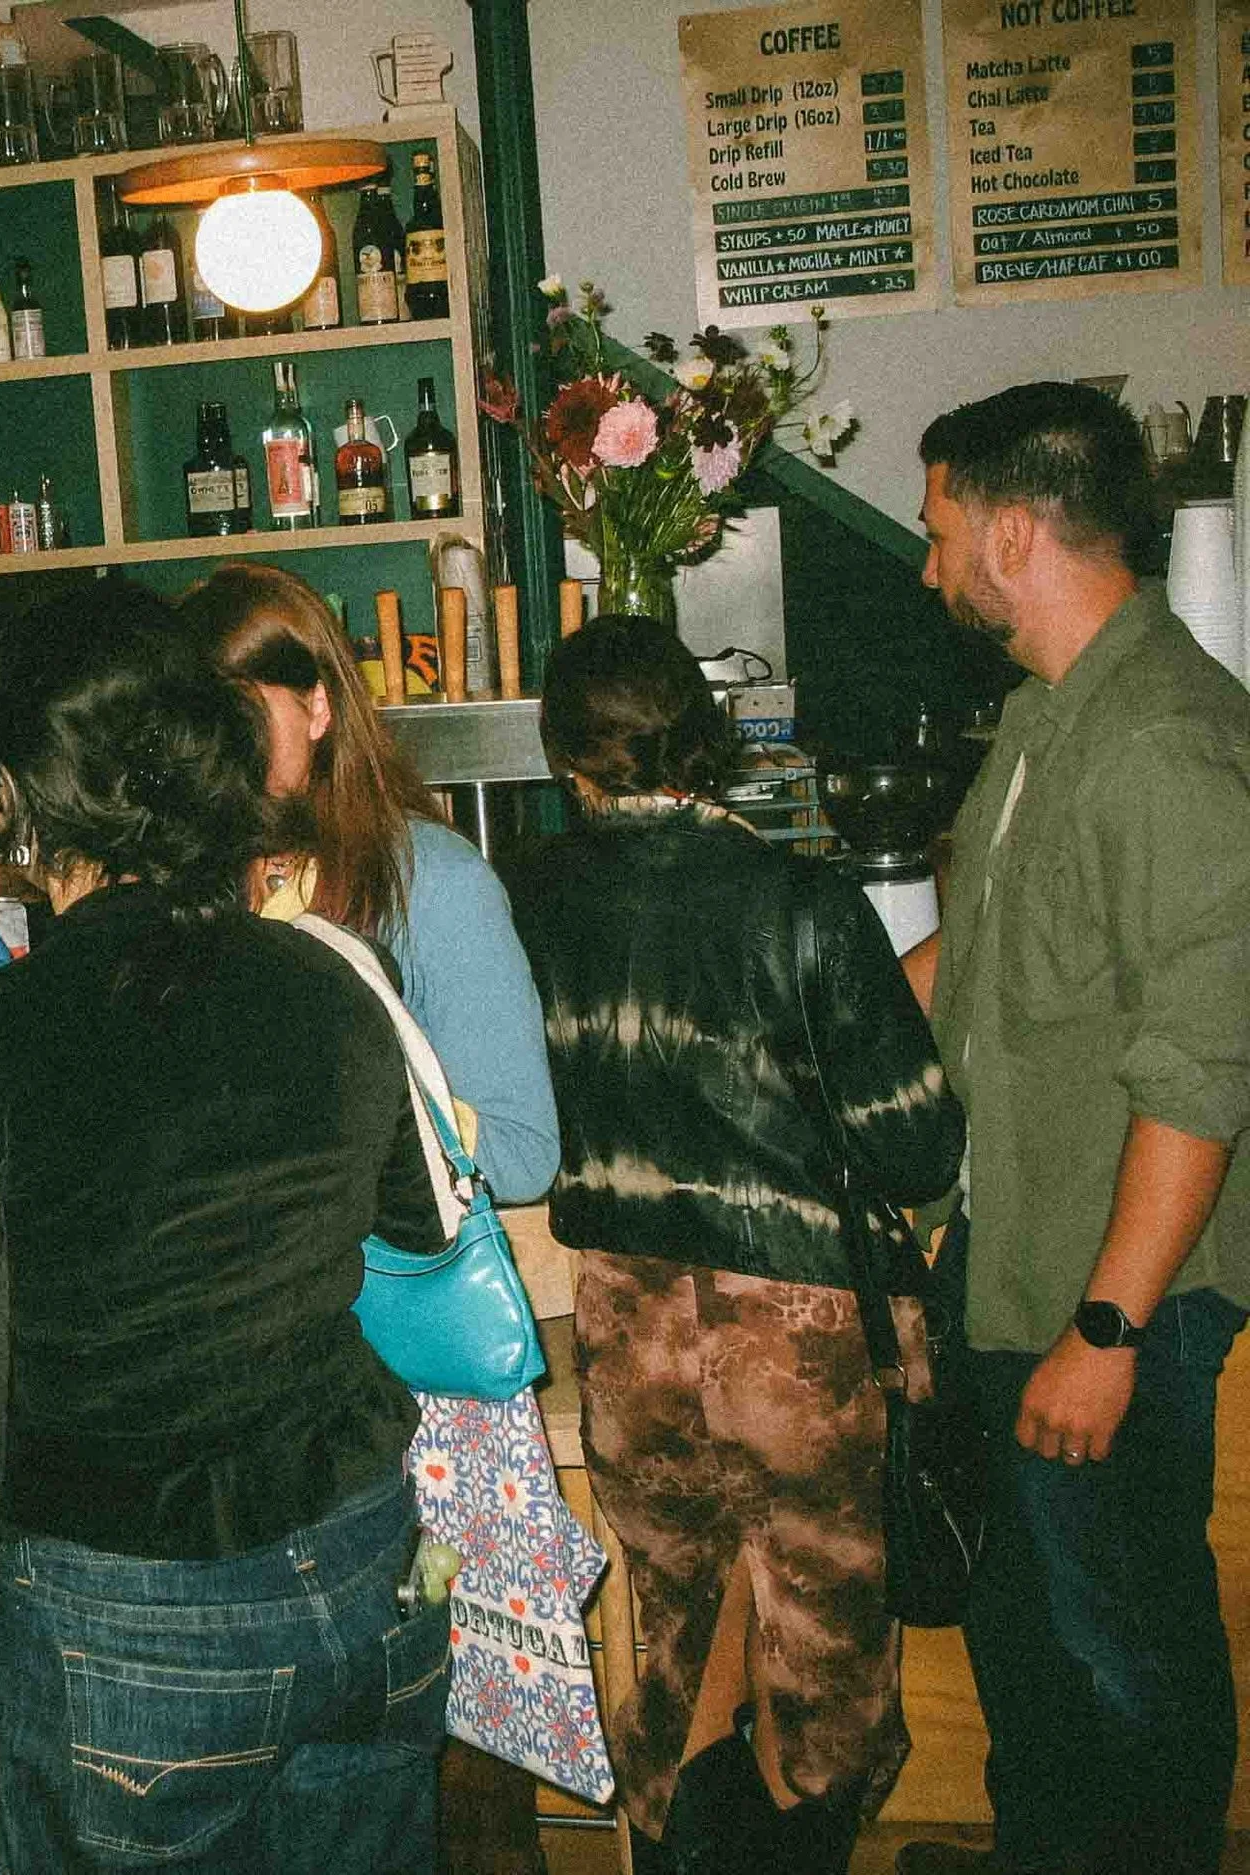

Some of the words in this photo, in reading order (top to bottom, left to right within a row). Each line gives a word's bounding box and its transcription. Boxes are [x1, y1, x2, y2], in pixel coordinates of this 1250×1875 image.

[1001, 0, 1042, 28] NOT
[760, 23, 841, 55] COFFEE
[967, 59, 1023, 80] Matcha
[1028, 54, 1071, 73] Latte
[705, 87, 748, 109] Small
[751, 86, 783, 107] Drip
[793, 79, 839, 101] (12oz)
[968, 87, 1001, 108] Chai
[707, 115, 750, 139] Large
[756, 112, 787, 134] Drip
[795, 106, 841, 130] (16oz)
[969, 118, 996, 137] Tea
[710, 146, 741, 167] Drip
[746, 140, 784, 160] Refill
[970, 146, 1000, 165] Iced
[1006, 144, 1033, 163] Tea
[711, 174, 743, 192] Cold
[749, 171, 786, 188] Brew
[971, 174, 997, 194] Hot
[1003, 168, 1080, 191] Chocolate
[717, 201, 765, 220] SINGLE
[977, 206, 1020, 226] ROSE
[1019, 200, 1099, 222] CARDAMOM
[1103, 195, 1134, 214] CHAI
[1147, 193, 1163, 211] 5
[720, 231, 771, 251] SYRUPS
[816, 221, 860, 241] MAPLE
[873, 217, 910, 237] HONEY
[980, 236, 1009, 252] oat
[1033, 228, 1092, 246] Almond
[720, 259, 774, 279] VANILLA
[788, 253, 832, 273] MOCHA
[848, 248, 889, 267] MINT
[723, 286, 772, 306] WHIP
[772, 279, 829, 301] CREAM
